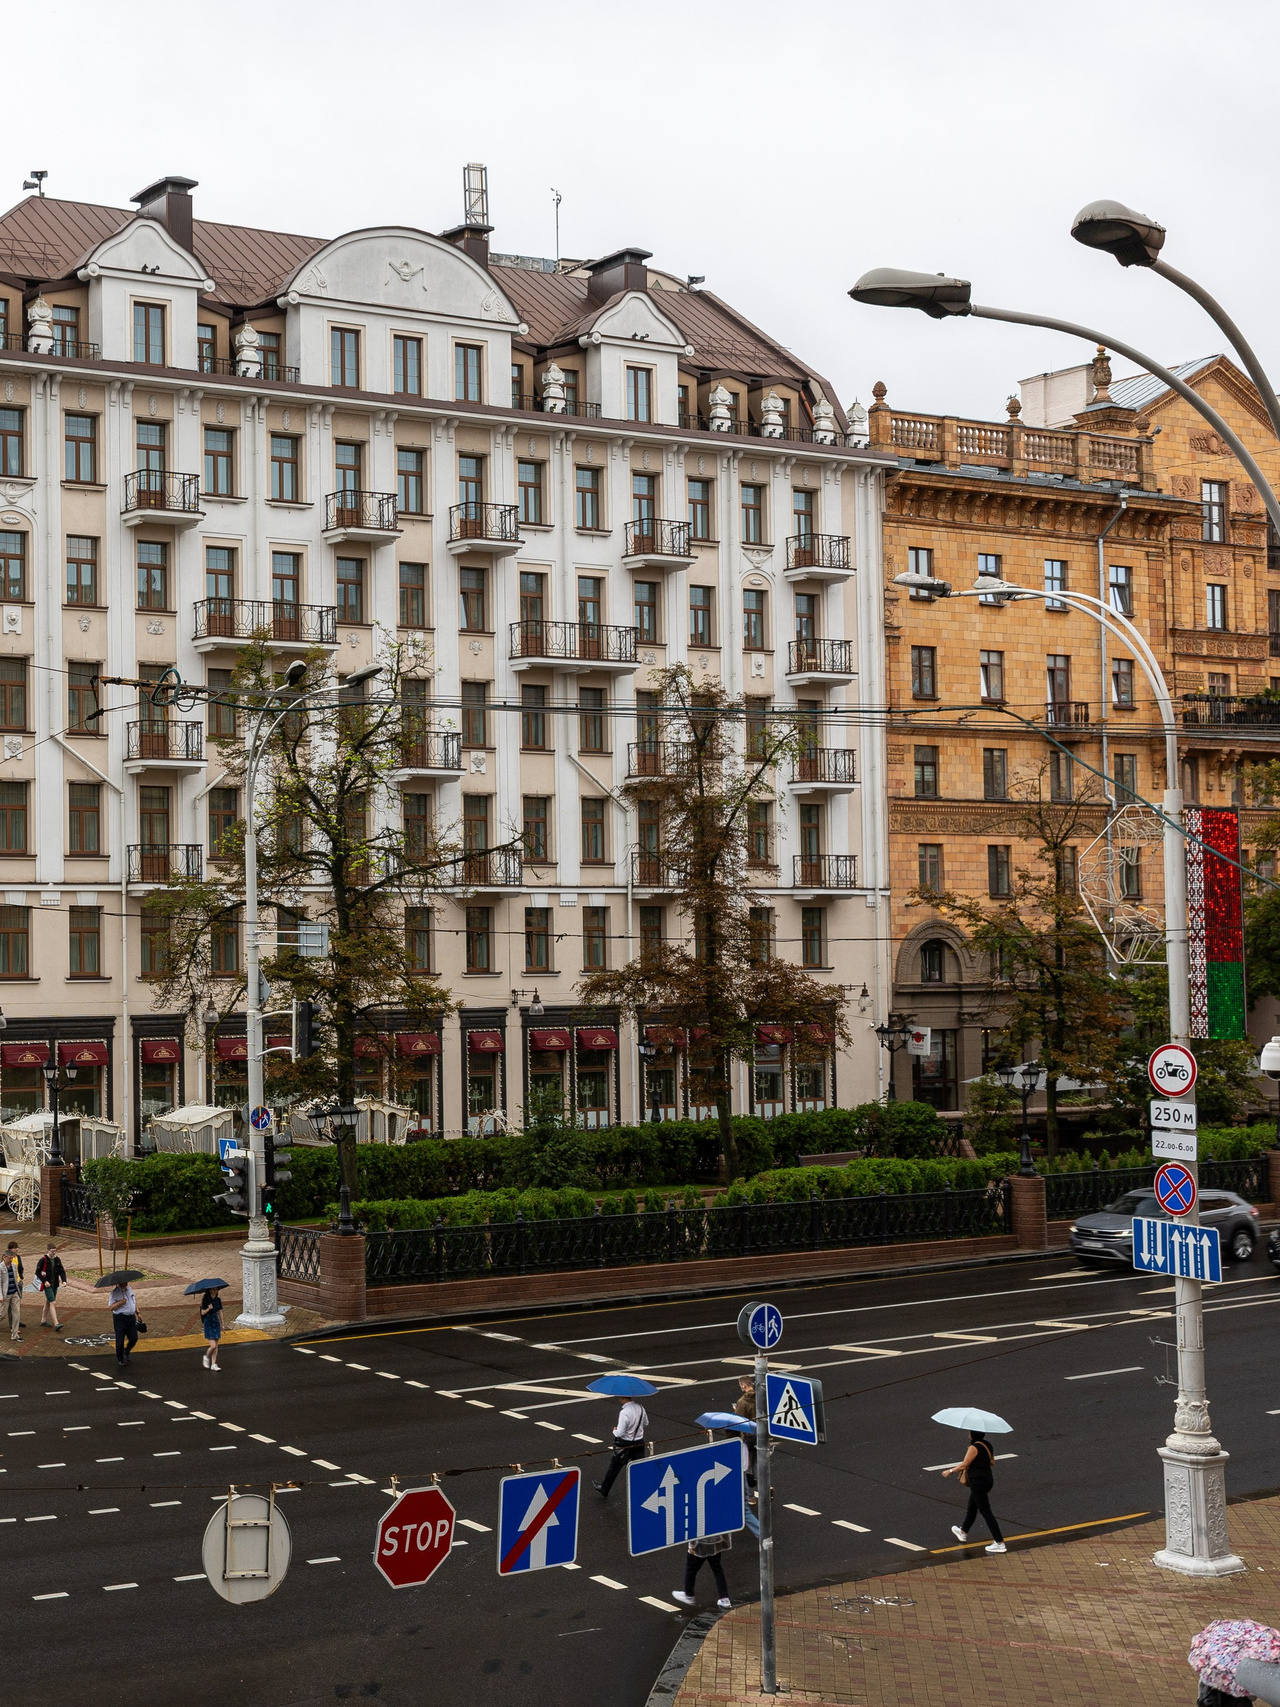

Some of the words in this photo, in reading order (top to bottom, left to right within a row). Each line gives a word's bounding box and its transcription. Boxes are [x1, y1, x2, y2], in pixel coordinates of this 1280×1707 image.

[1154, 1106, 1181, 1123] 250
[1155, 1139, 1194, 1152] 22.00-6.00
[381, 1519, 450, 1556] STOP
